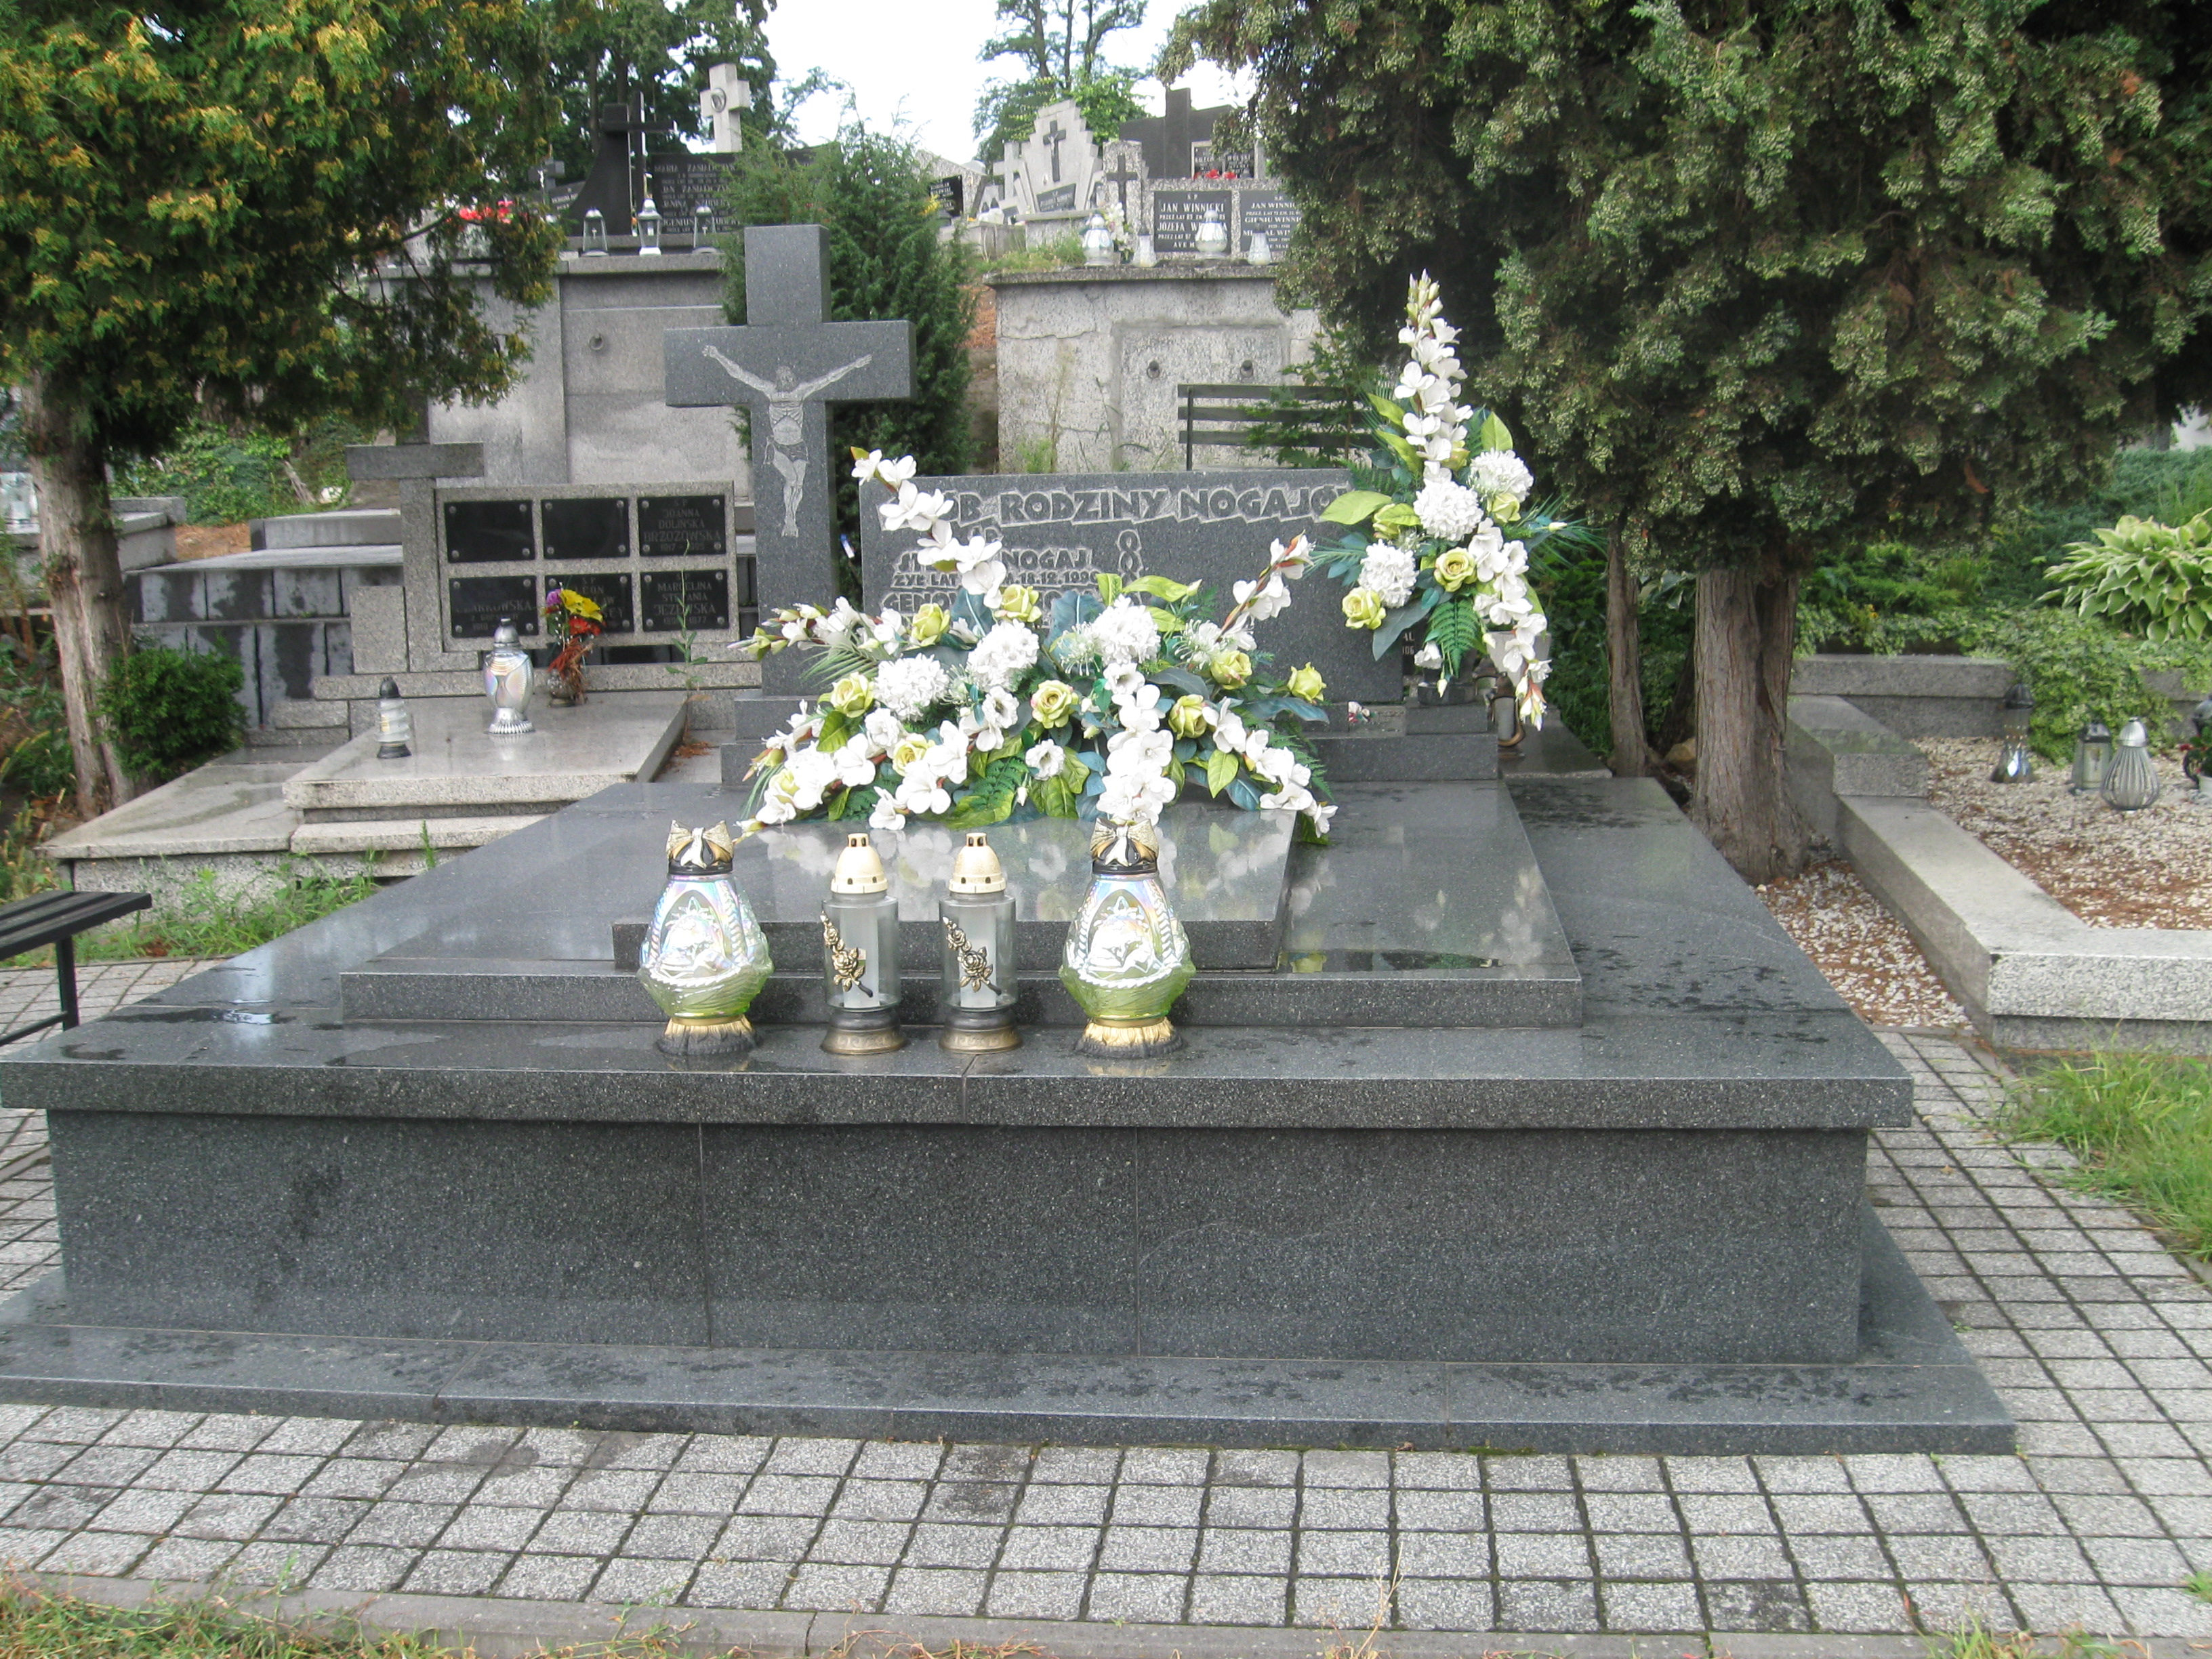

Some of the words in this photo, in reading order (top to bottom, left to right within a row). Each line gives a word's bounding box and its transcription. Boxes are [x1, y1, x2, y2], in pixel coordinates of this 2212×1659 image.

[1160, 203, 1179, 213] JAN
[1183, 203, 1225, 213] WINNICKI
[1157, 221, 1185, 232] JÓZEFA
[999, 485, 1171, 526] RODZINY
[1179, 484, 1349, 522] NOGAJÓ
[662, 508, 701, 518] JOANNA
[643, 529, 722, 543] BRZOZOWSKA
[929, 571, 958, 588] LAT
[661, 592, 709, 602] STEANIA
